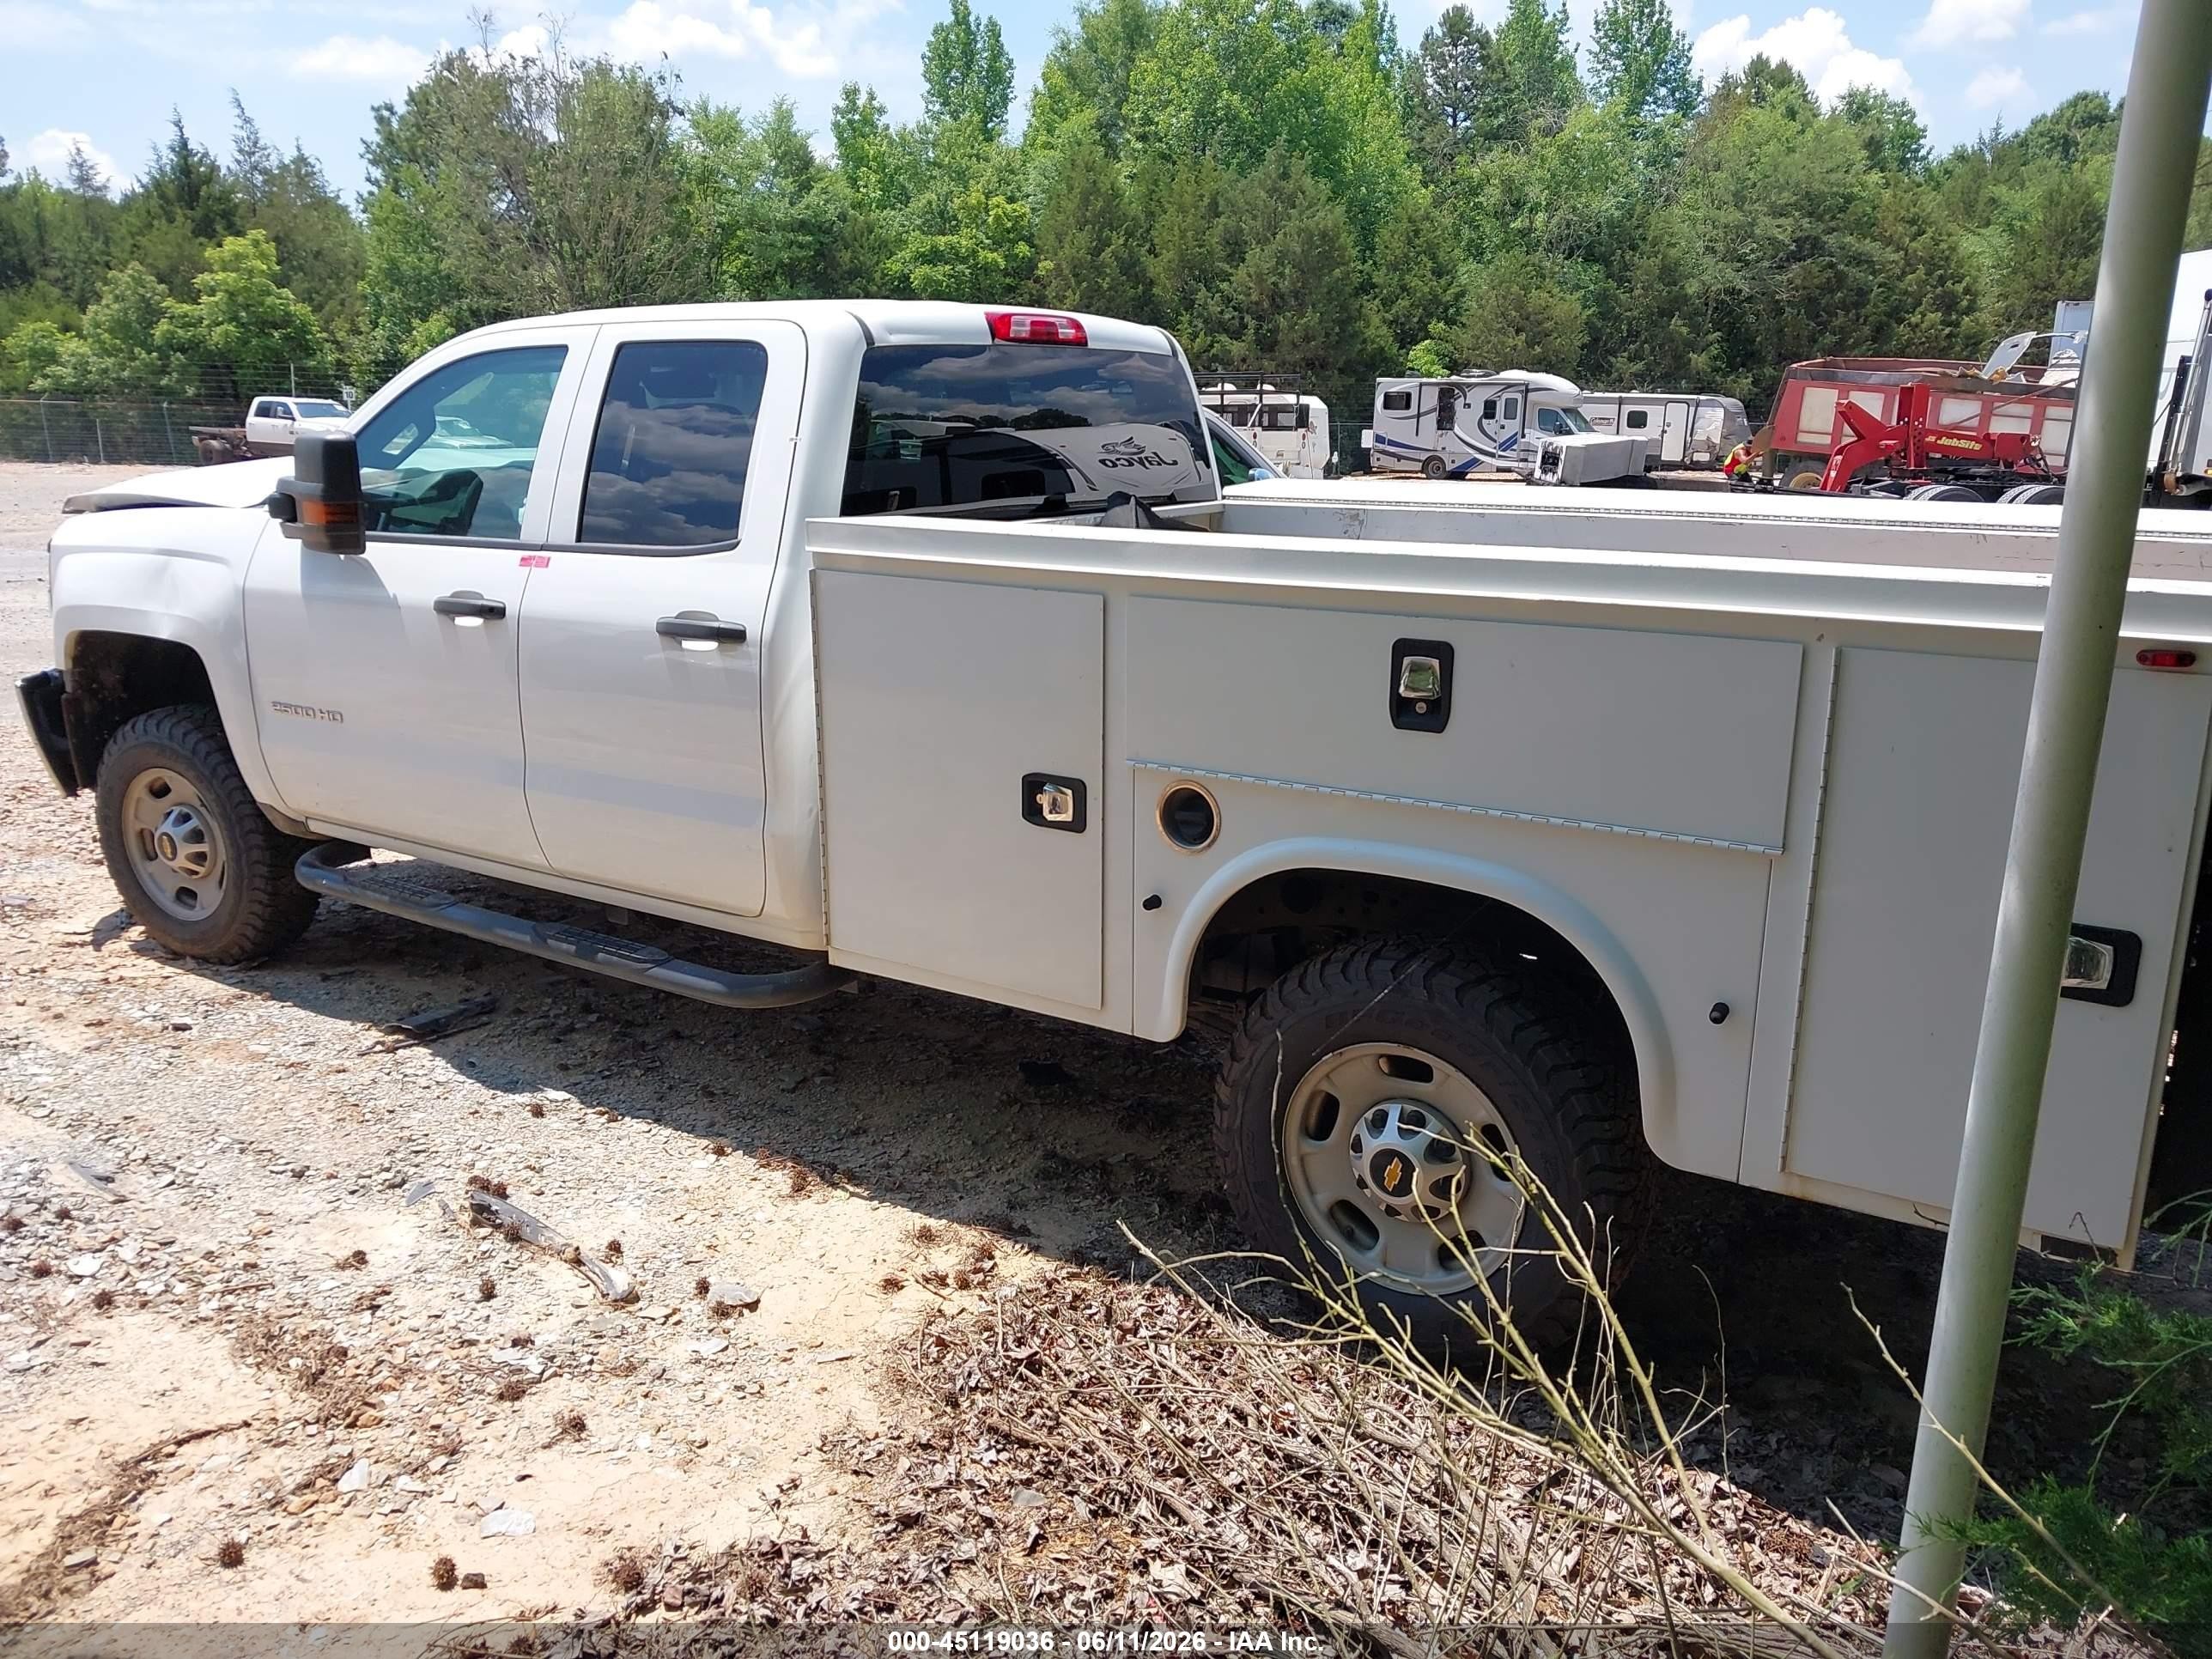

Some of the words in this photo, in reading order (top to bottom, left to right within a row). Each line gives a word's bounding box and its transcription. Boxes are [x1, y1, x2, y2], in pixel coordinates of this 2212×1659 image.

[1937, 436, 1983, 451] JobSite
[271, 701, 317, 720] 2500
[317, 708, 344, 724] HD
